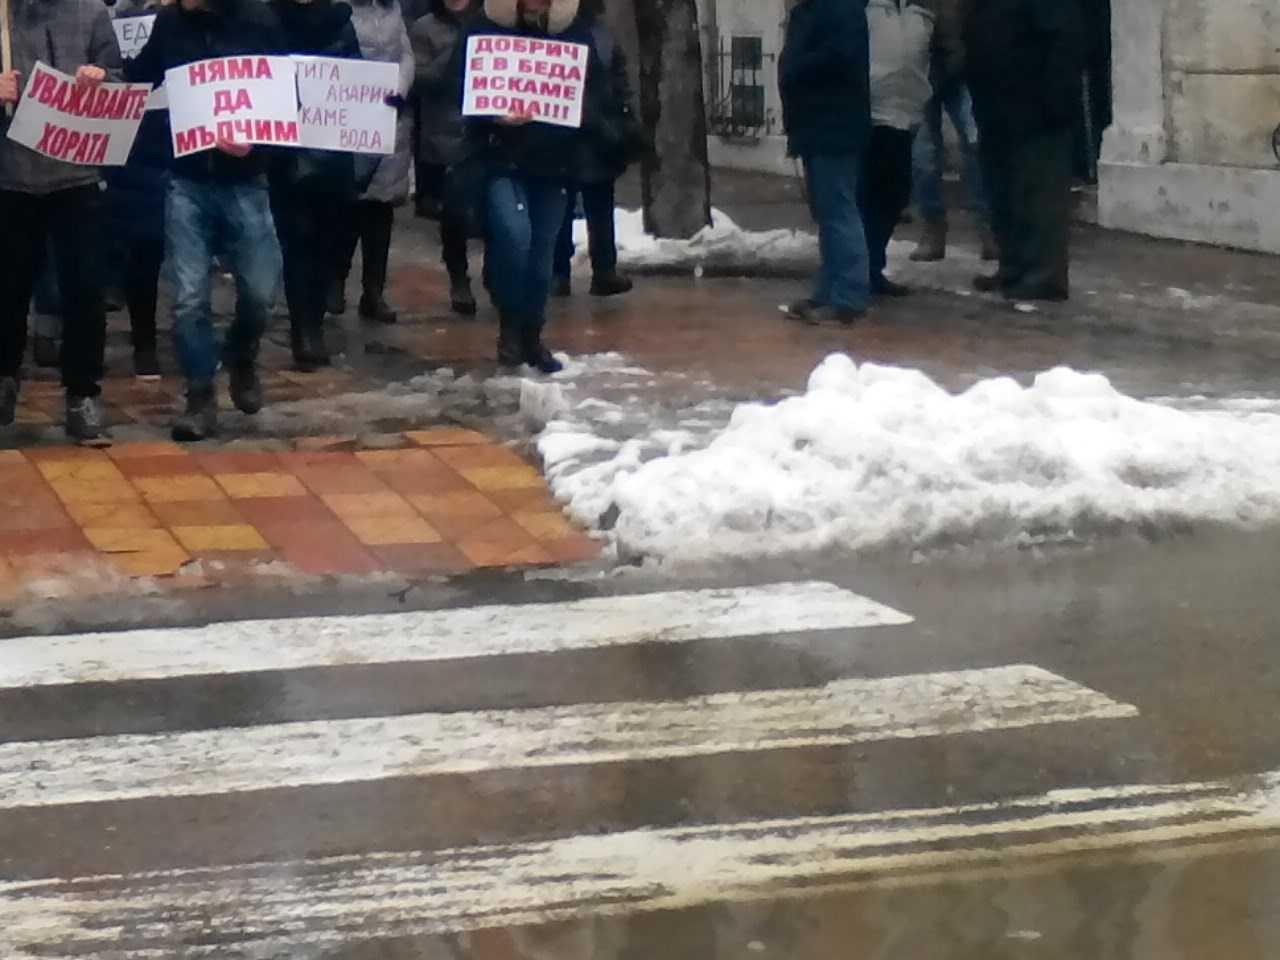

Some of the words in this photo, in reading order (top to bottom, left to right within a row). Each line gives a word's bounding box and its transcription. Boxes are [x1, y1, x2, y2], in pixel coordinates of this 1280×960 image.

[475, 38, 579, 60] ДОБРИЧ
[188, 58, 273, 86] НЯМА
[293, 61, 340, 81] ТИГА
[470, 57, 484, 71] Е
[493, 57, 508, 71] В
[518, 58, 581, 81] БЕДА
[27, 68, 149, 120] УВАЖАВАЙТЕ
[472, 76, 577, 101] ИСКАМЕ
[213, 89, 253, 117] ДА
[475, 95, 570, 120] ВОДА!!!
[301, 108, 348, 127] КАМЕ
[36, 122, 111, 164] ХОРАТА
[175, 119, 299, 155] МЪЛЧИМ
[340, 129, 382, 150] ВОДА
